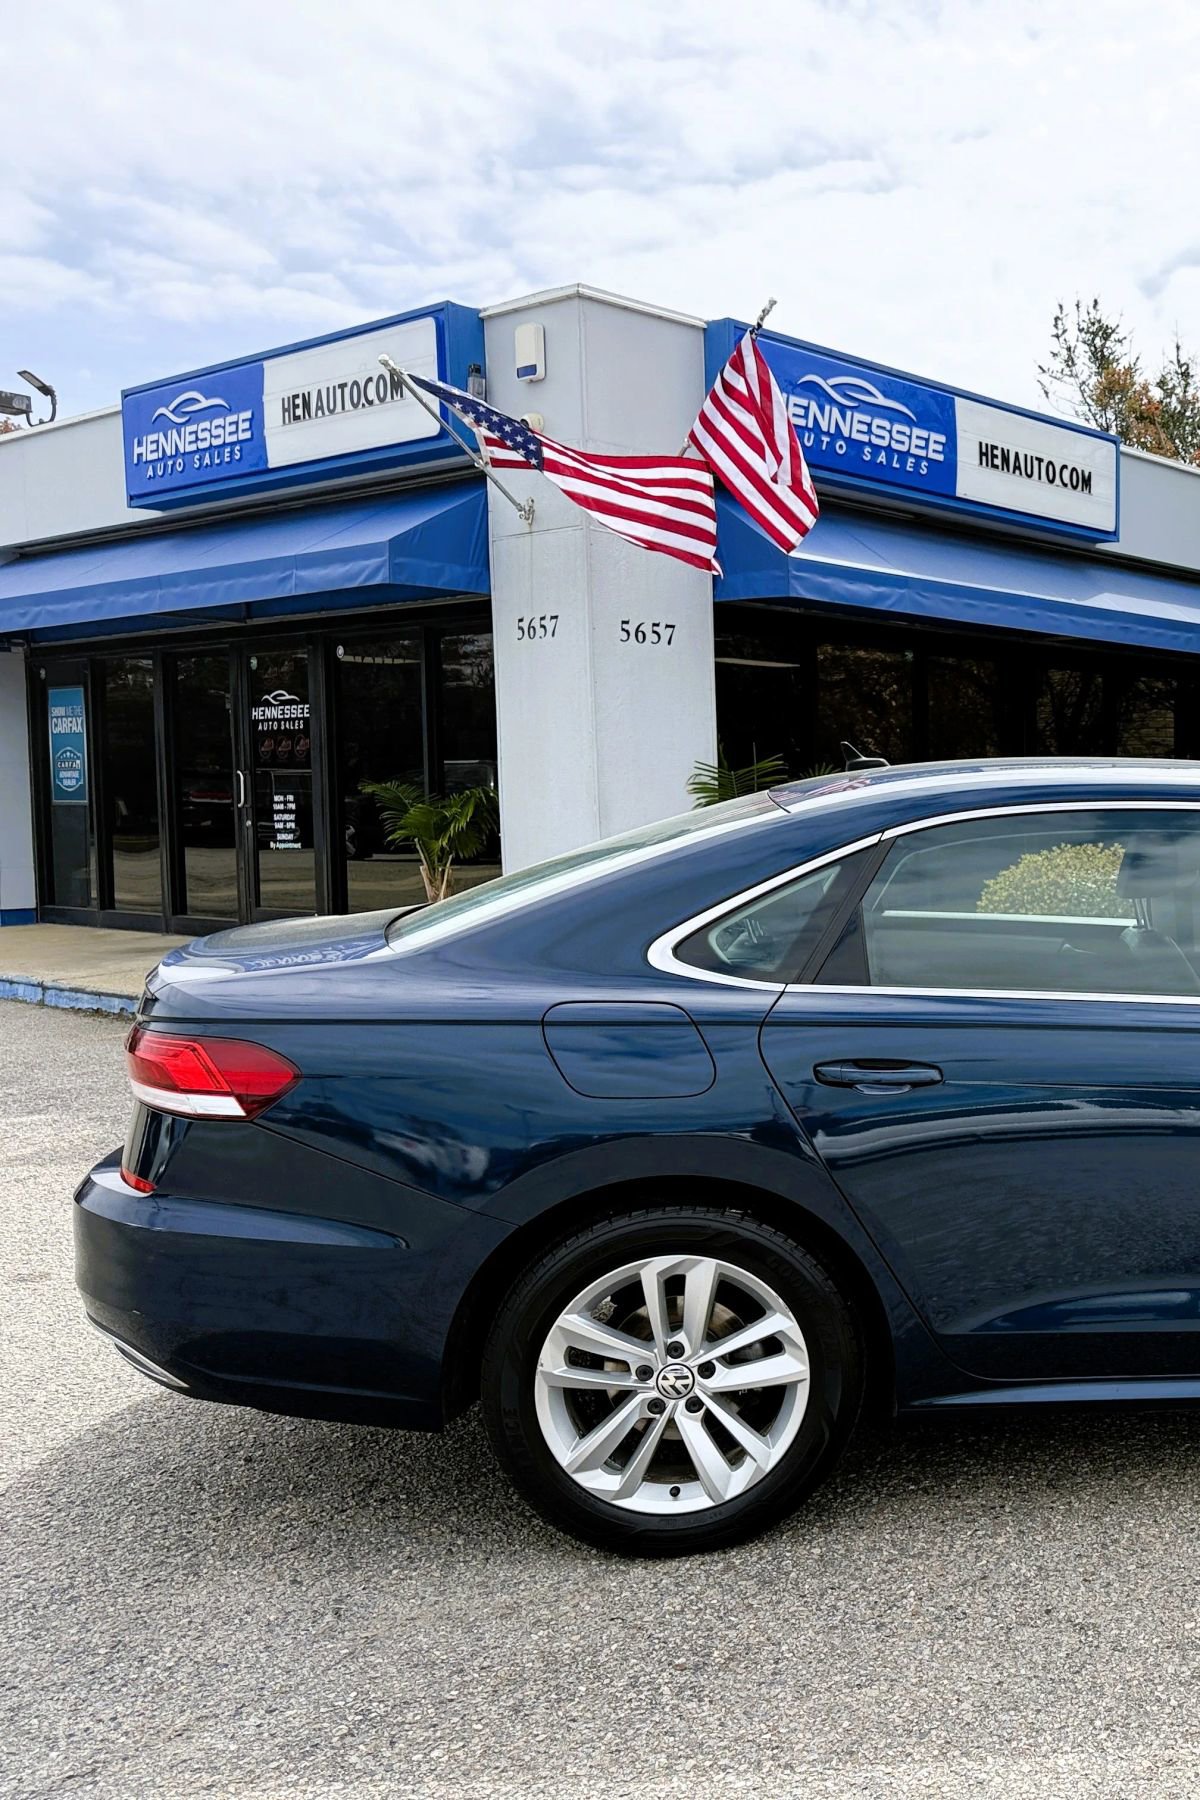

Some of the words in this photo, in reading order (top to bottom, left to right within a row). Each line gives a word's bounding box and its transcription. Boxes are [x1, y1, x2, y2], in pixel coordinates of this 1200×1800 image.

[133, 409, 253, 464] HENNESSEE
[146, 459, 184, 479] AUTO
[194, 444, 241, 469] SALES
[803, 431, 847, 455] UTO
[863, 448, 929, 475] SALES
[517, 614, 559, 641] 5657
[620, 619, 677, 646] 5657
[52, 717, 83, 734] CARFAX
[252, 704, 310, 720] HENNESSEE
[258, 721, 278, 731] AUTO
[281, 720, 304, 730] SALES
